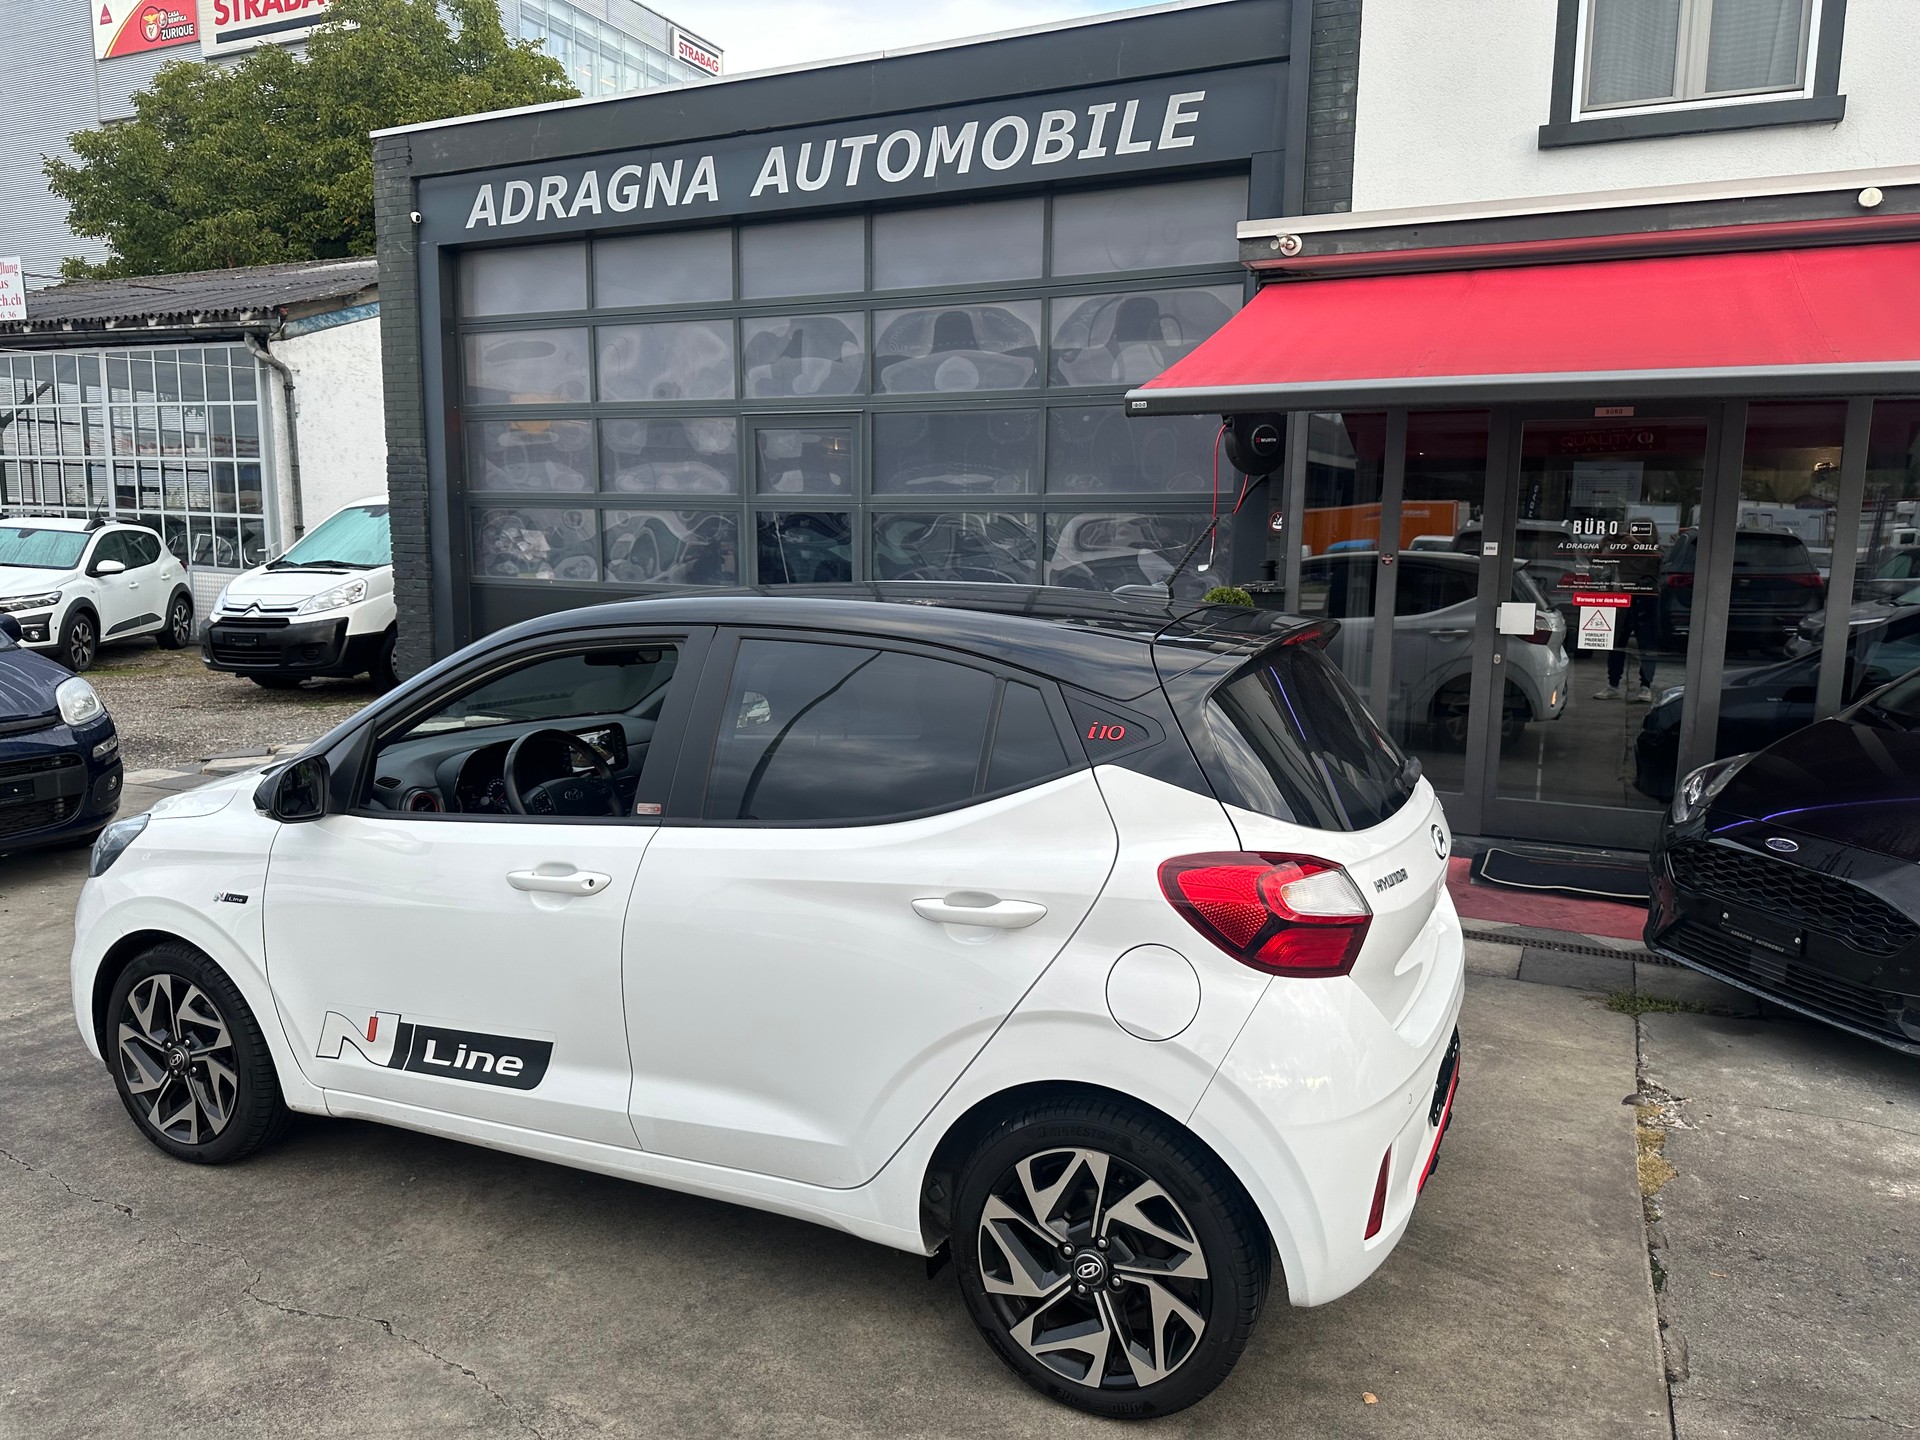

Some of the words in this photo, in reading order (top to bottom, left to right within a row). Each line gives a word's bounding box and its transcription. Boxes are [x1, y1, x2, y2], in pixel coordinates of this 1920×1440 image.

[161, 24, 195, 40] ZURIQUE
[678, 41, 719, 73] STRABAG
[465, 155, 719, 229] ADRAGNA
[749, 90, 1206, 197] AUTOMOBILE
[0, 293, 22, 307] h.ch
[1573, 518, 1618, 535] BÜRO
[1576, 596, 1596, 604] Warnung
[423, 1039, 525, 1077] Line
